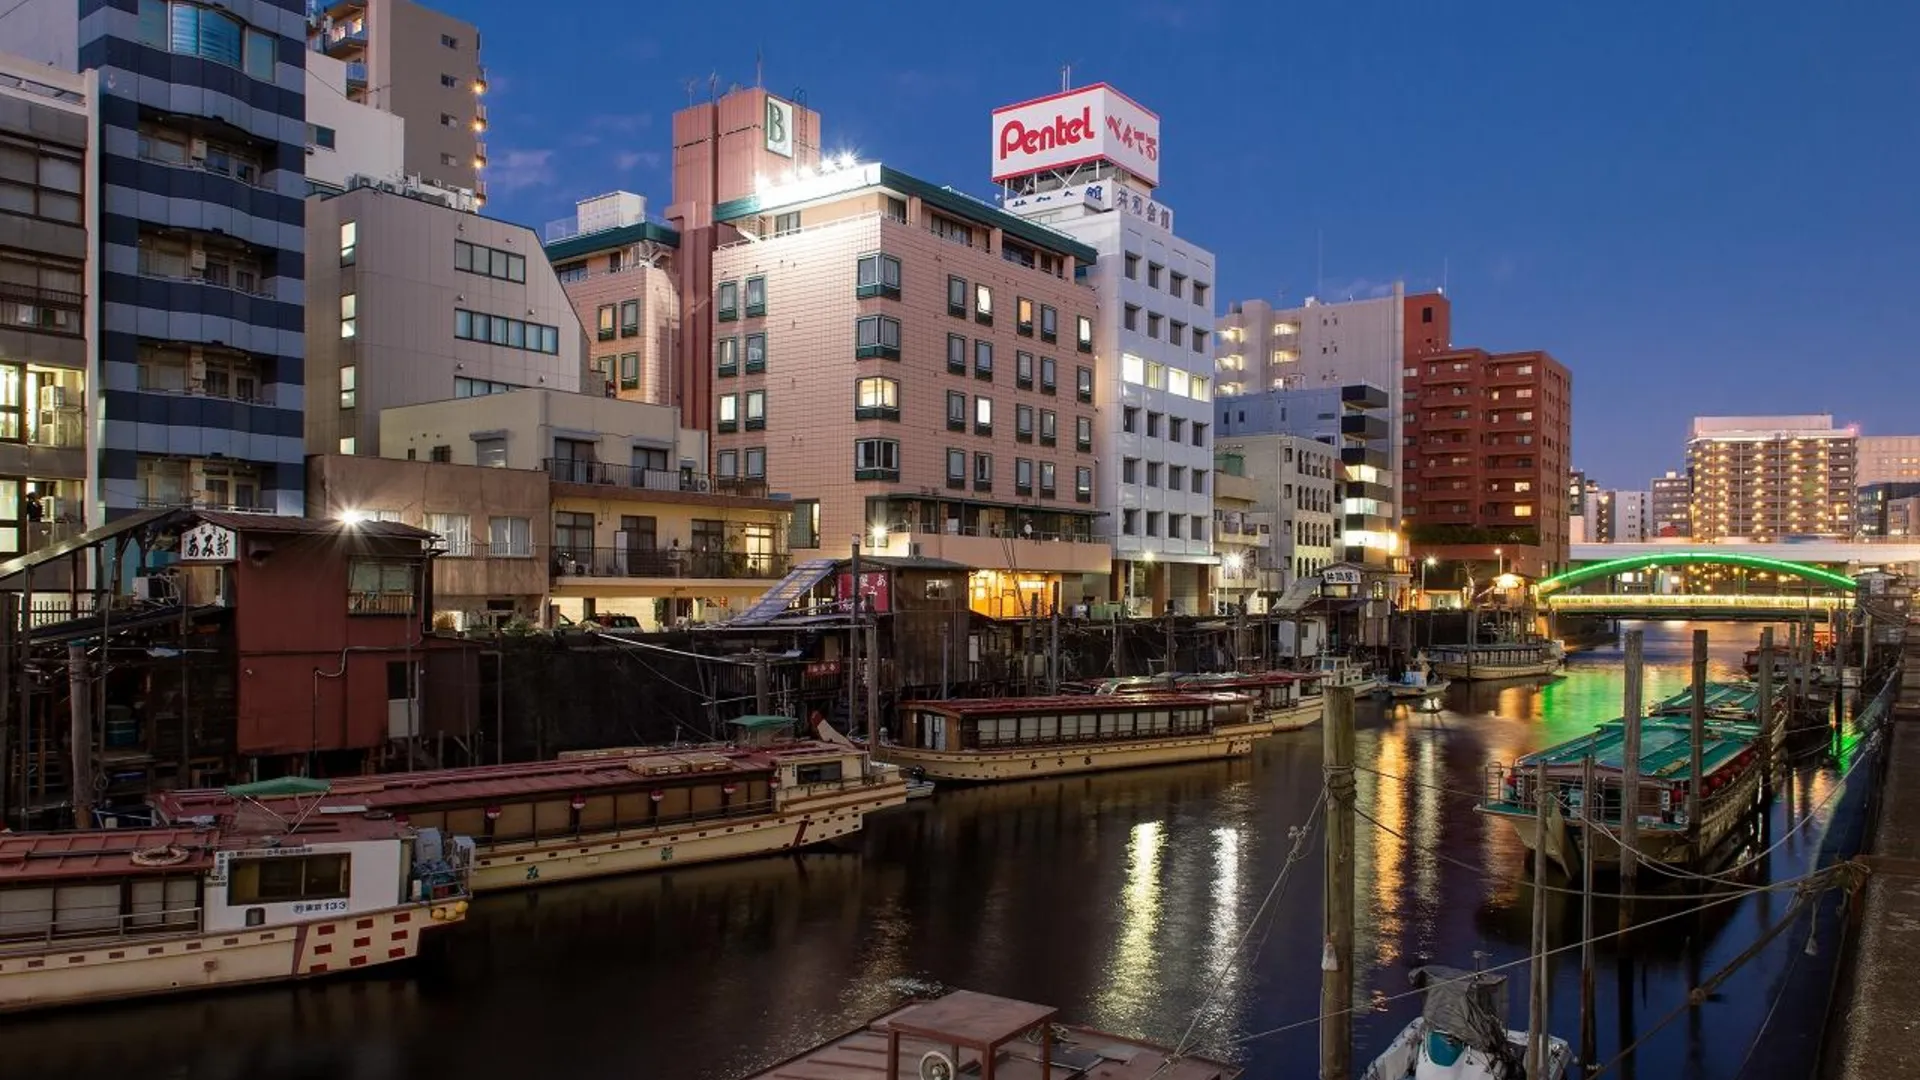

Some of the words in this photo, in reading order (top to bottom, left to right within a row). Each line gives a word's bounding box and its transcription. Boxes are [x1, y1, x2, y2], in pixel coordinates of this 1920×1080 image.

[768, 102, 786, 143] B
[1000, 106, 1095, 160] Pentel
[1105, 114, 1157, 162] ぺんてる
